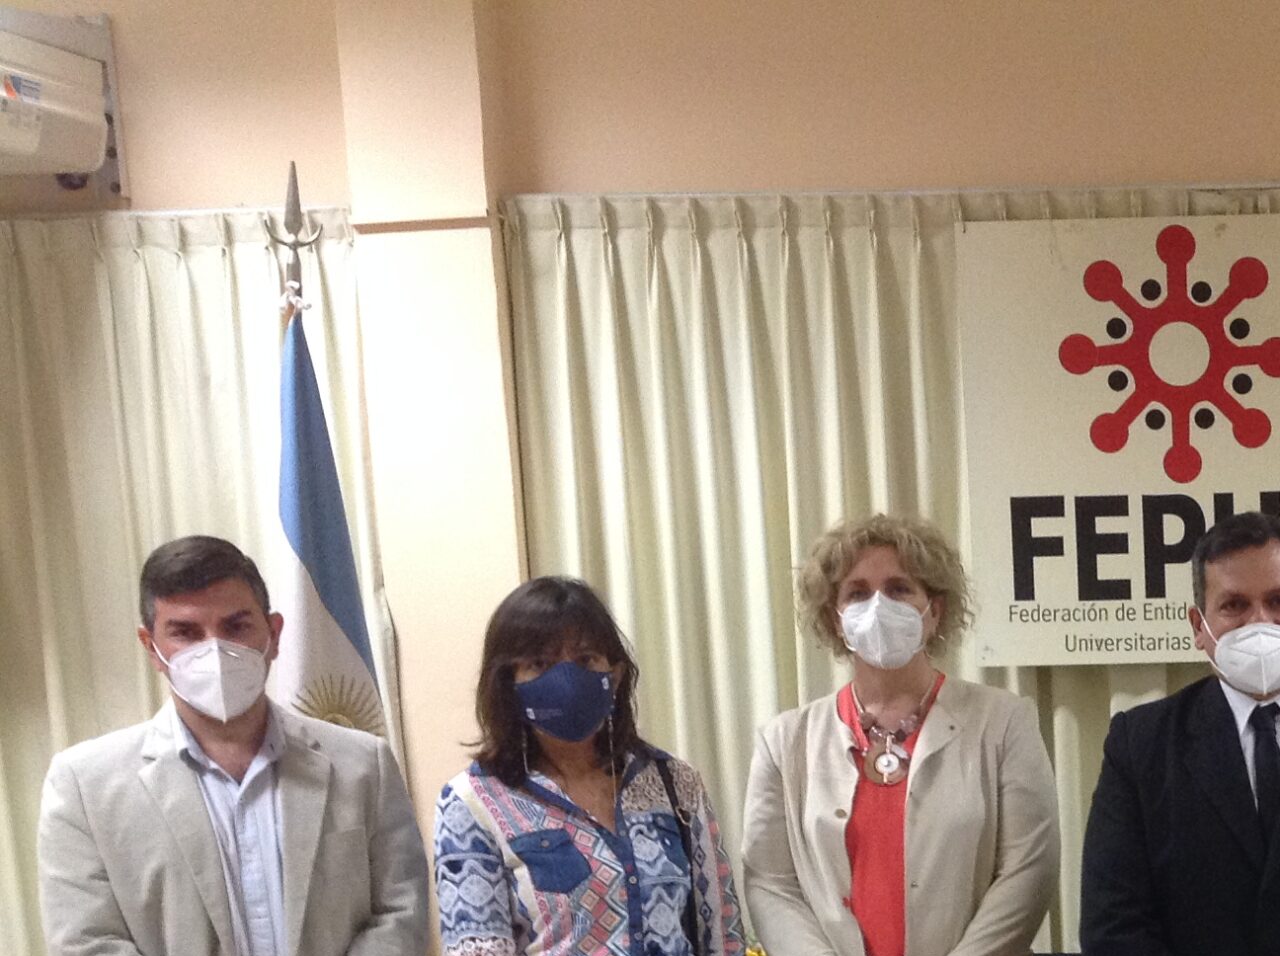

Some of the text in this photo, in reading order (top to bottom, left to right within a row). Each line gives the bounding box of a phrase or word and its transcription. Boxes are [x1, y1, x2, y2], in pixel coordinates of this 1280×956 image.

[1008, 603, 1109, 623] Federación
[1115, 603, 1137, 622] de
[1143, 601, 1188, 621] Entid
[1065, 632, 1192, 652] Universitarias
